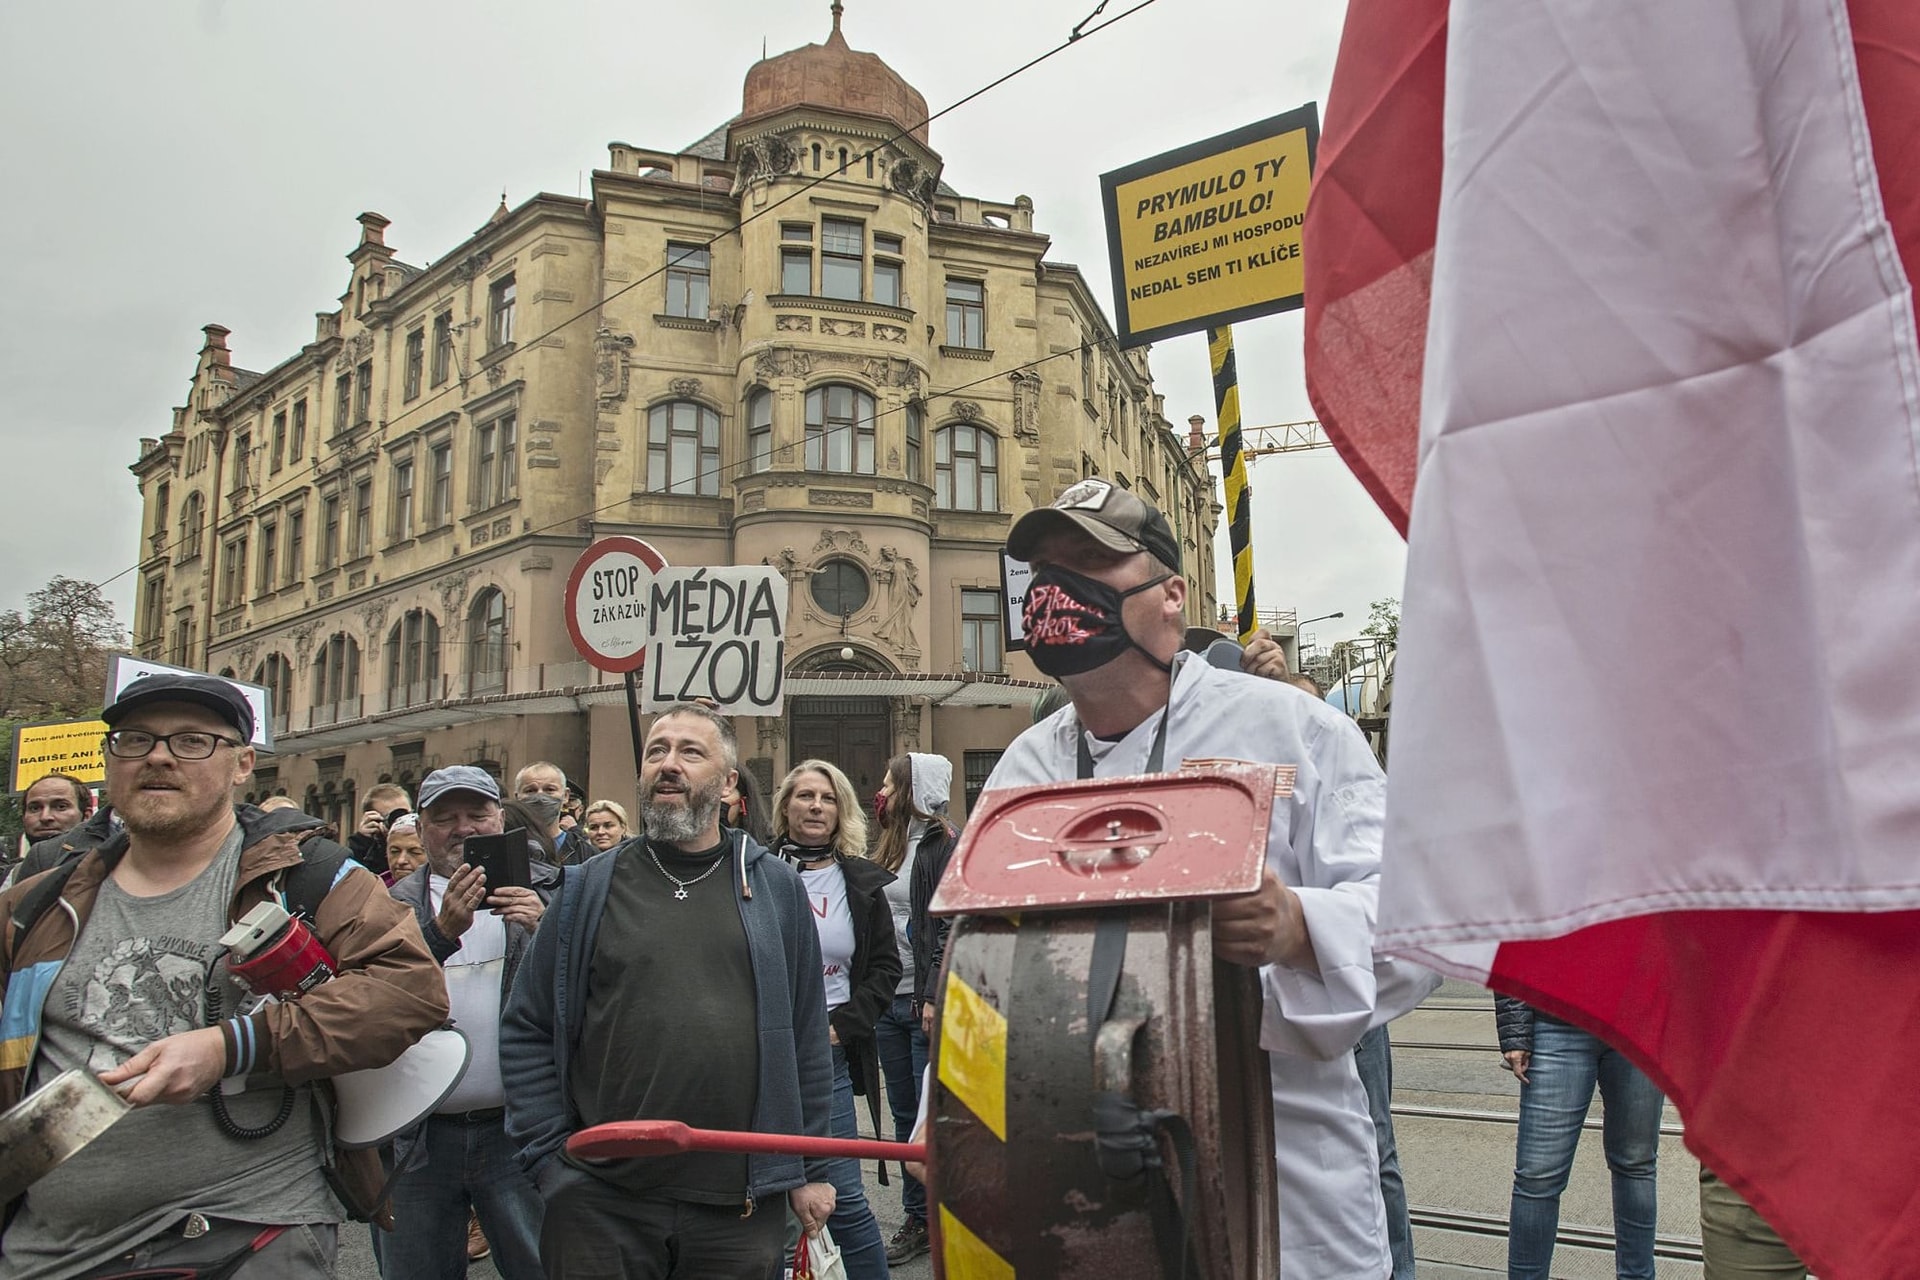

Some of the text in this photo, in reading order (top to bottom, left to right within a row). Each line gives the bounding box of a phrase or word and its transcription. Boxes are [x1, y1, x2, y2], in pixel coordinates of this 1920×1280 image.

[1136, 155, 1287, 219] PRYMULO TY
[1153, 190, 1274, 242] BAMBULO!
[1134, 213, 1304, 271] NEZAVÍREJ MI HOSPODU
[1130, 243, 1301, 301] NEDAL SEM TI KLÍČE
[593, 565, 639, 600] STOP
[650, 567, 782, 636] MÉDIA
[653, 634, 785, 706] LŽOU
[71, 750, 93, 759] ANI
